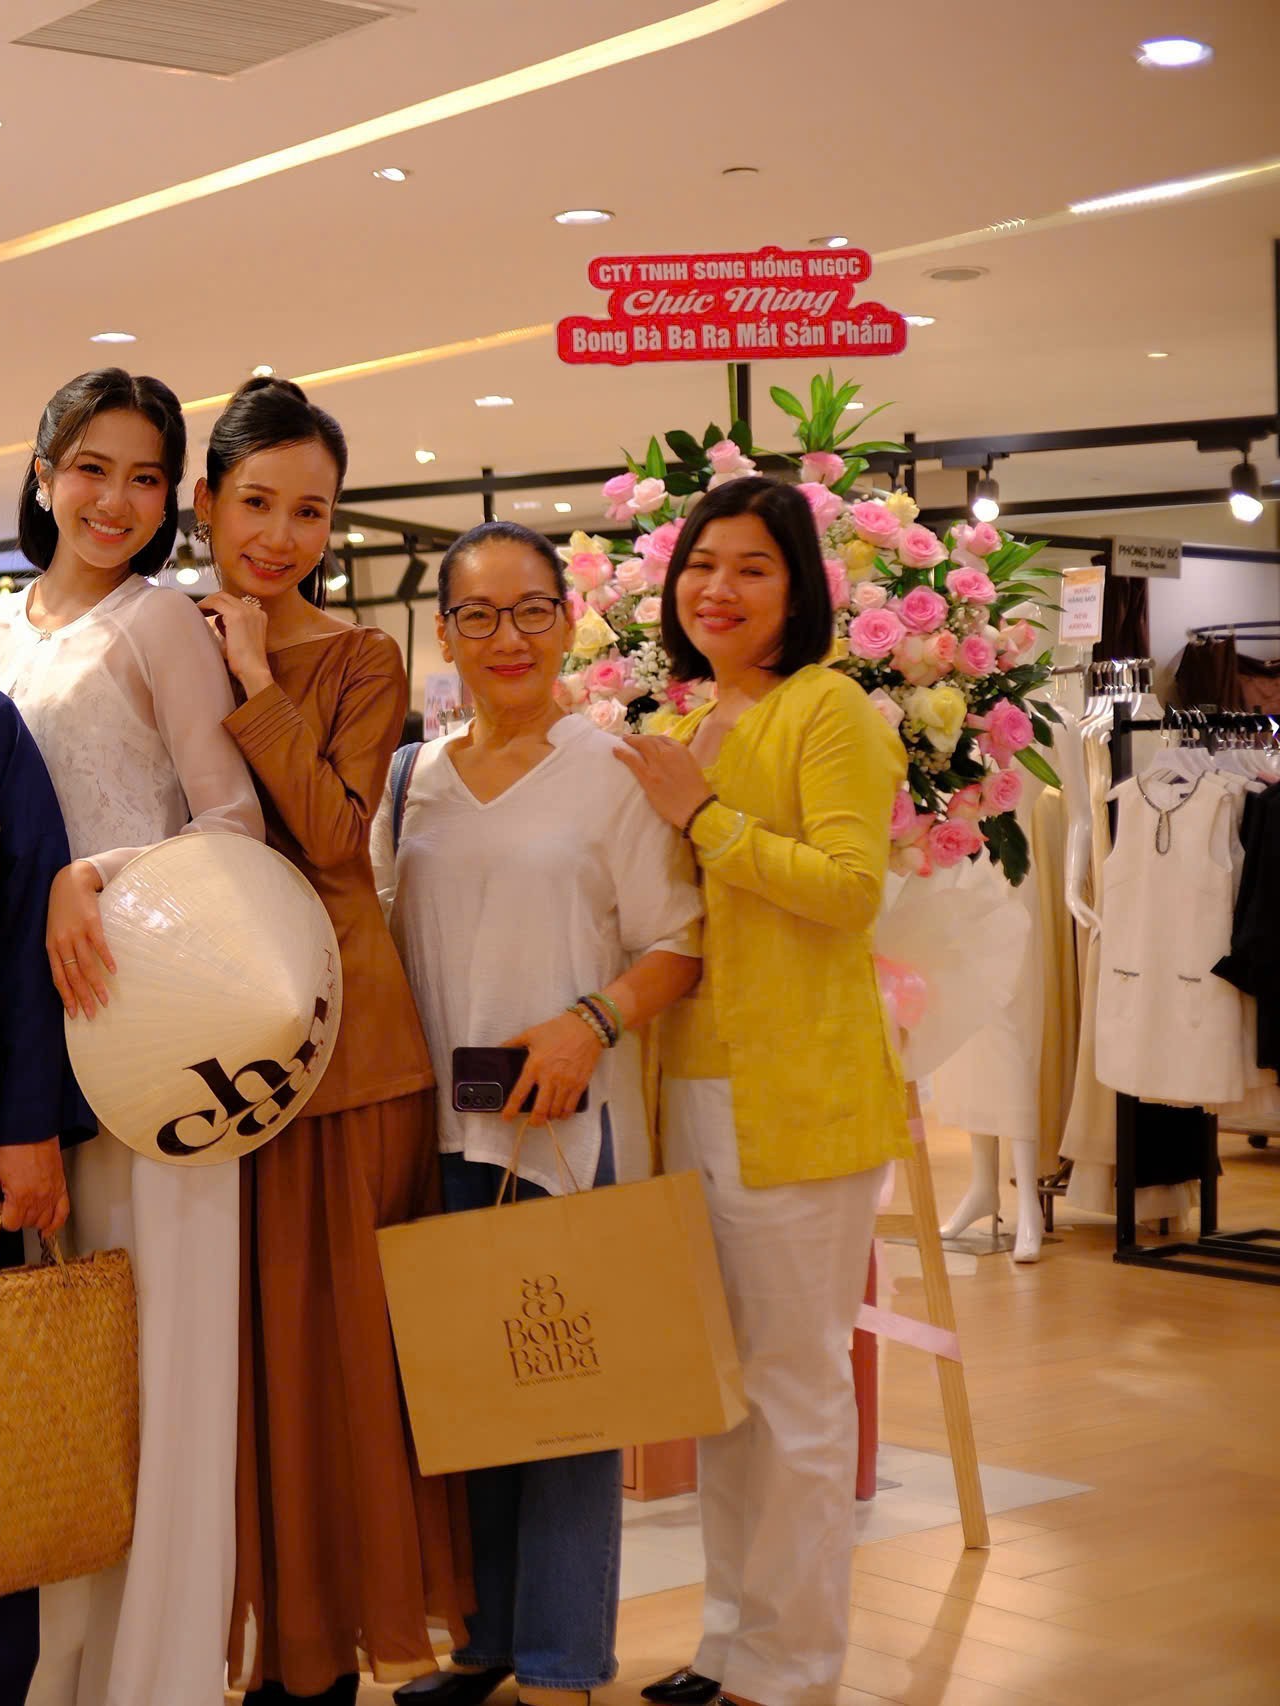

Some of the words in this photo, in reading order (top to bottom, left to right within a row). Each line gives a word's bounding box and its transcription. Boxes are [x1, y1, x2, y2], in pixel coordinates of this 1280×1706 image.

[599, 263, 632, 282] CTY
[638, 263, 688, 281] TNHH
[694, 261, 745, 280] SONG
[751, 254, 802, 278] HỒNG
[808, 256, 860, 279] NGỌC
[623, 288, 714, 316] Chúc
[724, 286, 839, 317] Mừng
[572, 327, 627, 355] Bong
[633, 325, 662, 351] Bà
[668, 324, 696, 350] Ba
[702, 324, 731, 349] Ra
[736, 317, 778, 348] Mắt
[784, 319, 825, 346] Sản
[831, 315, 892, 345] Phẩm
